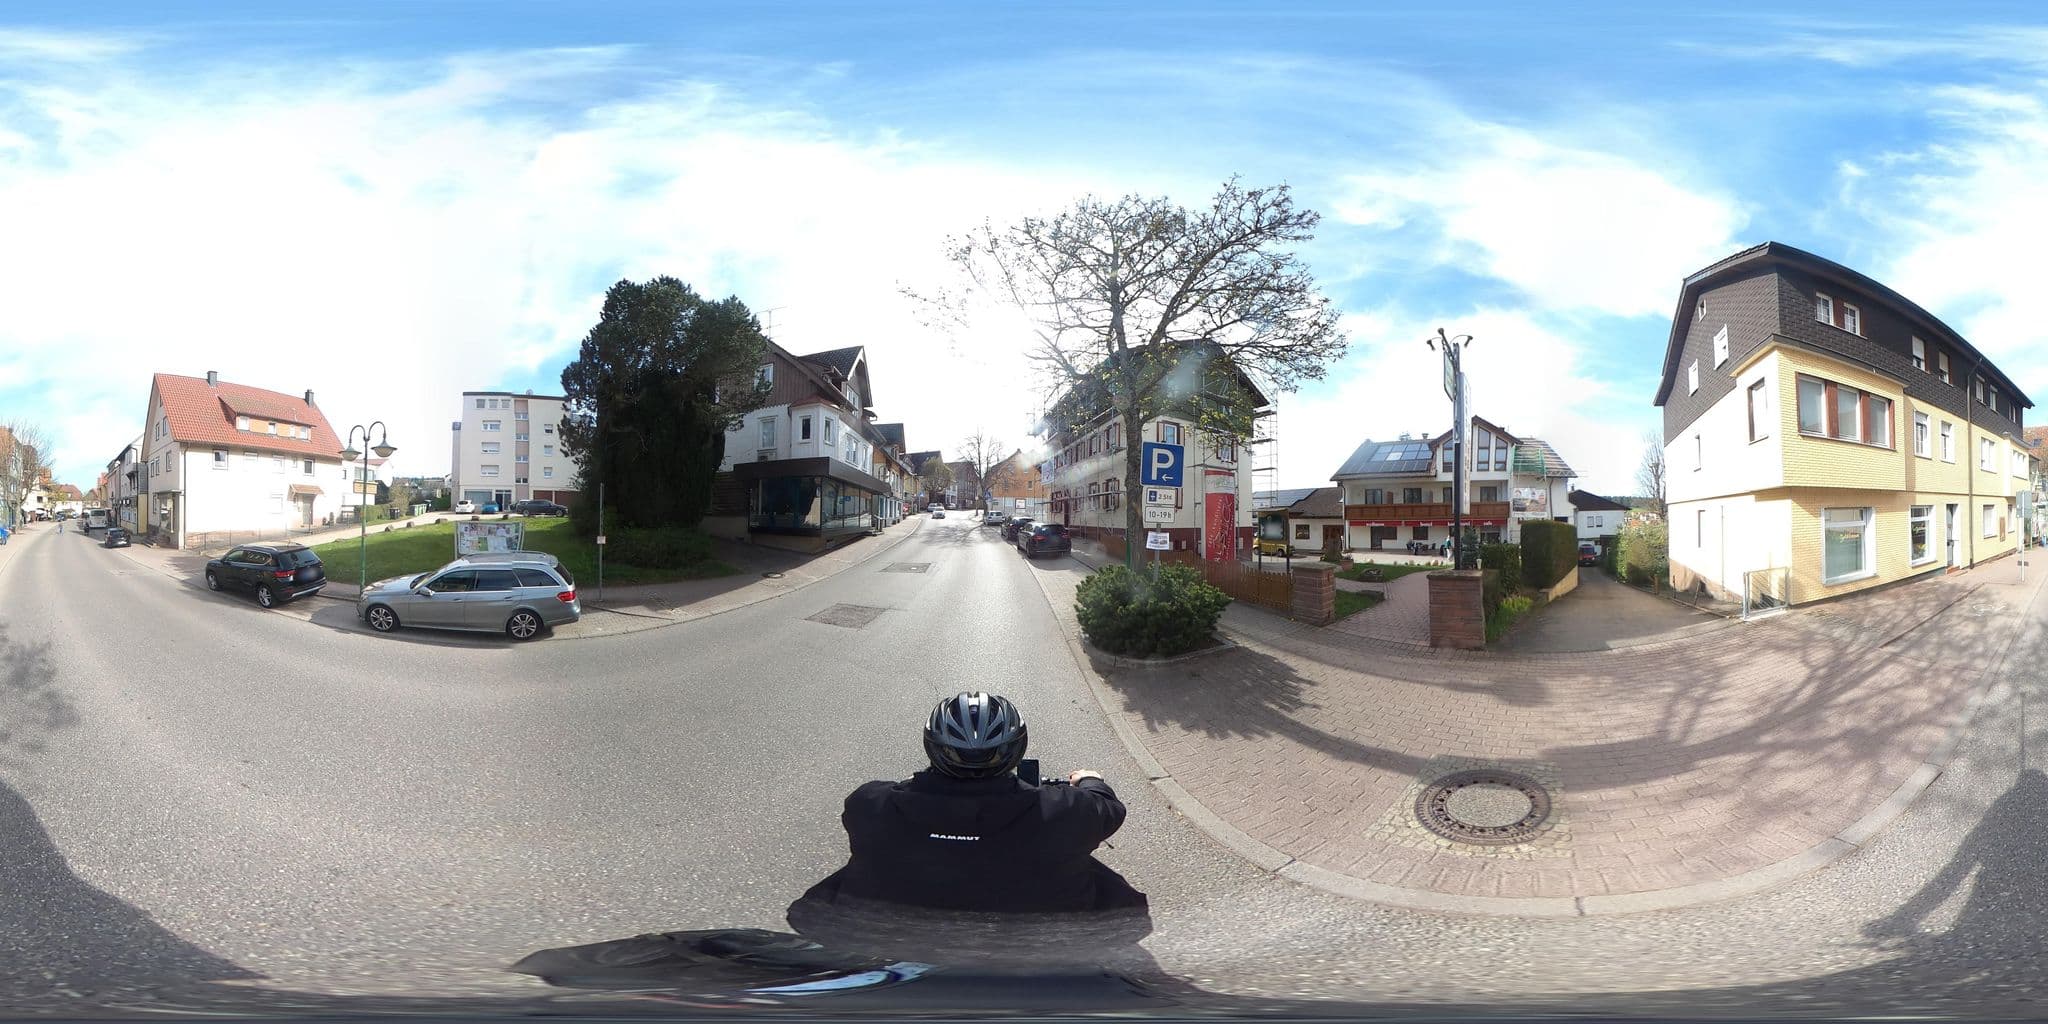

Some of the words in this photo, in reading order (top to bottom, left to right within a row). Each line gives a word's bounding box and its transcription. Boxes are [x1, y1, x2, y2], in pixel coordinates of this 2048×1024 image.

[1152, 448, 1174, 480] P
[1149, 510, 1167, 518] 10-19
[930, 833, 980, 841] MAMMUT
